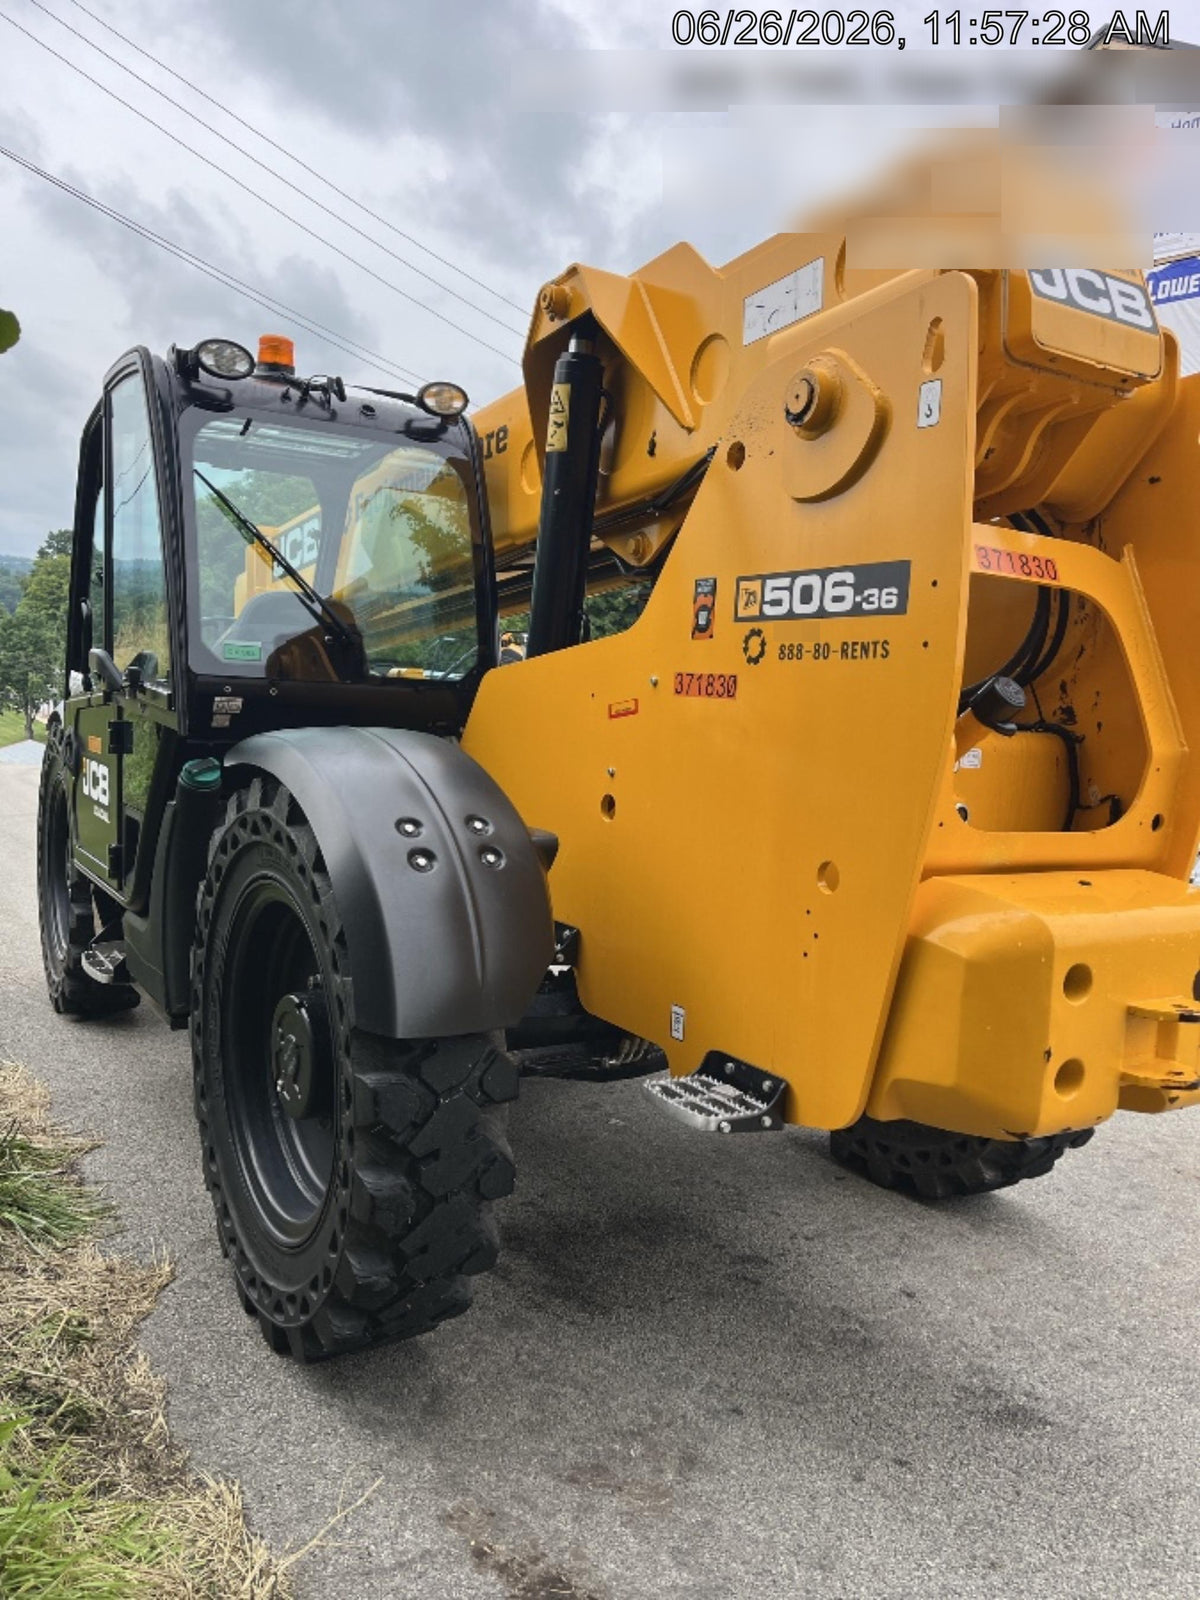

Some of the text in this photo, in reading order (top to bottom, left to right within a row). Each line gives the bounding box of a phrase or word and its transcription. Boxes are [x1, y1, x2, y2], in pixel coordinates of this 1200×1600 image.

[1032, 269, 1153, 328] JCB
[977, 546, 1057, 580] 371830
[778, 640, 890, 661] 888-80-RENTS
[674, 672, 737, 698] 371830
[83, 757, 109, 806] JCB
